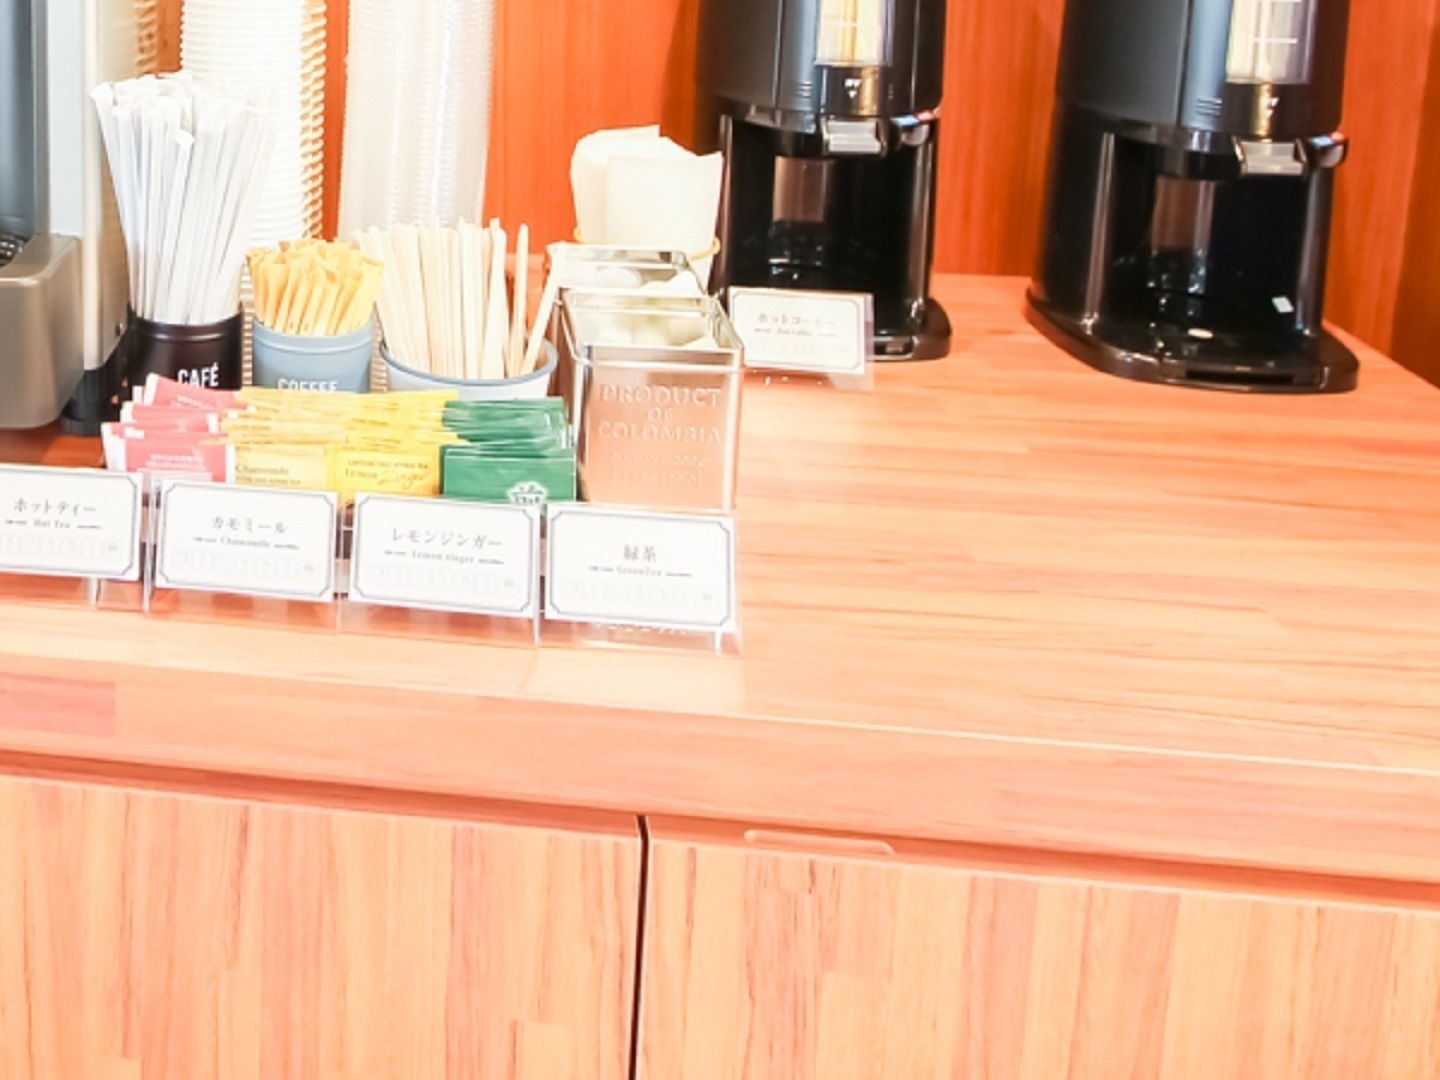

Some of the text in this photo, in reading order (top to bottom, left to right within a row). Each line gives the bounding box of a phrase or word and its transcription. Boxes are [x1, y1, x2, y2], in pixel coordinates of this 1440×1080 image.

[177, 361, 219, 388] CAFÉ
[600, 384, 721, 407] PRODUCT
[598, 421, 721, 446] COLOMBIA
[14, 497, 97, 517] ホットティー
[210, 515, 288, 535] カモミール
[392, 527, 503, 549] レモンジンガー
[623, 543, 657, 563] 緑茶
